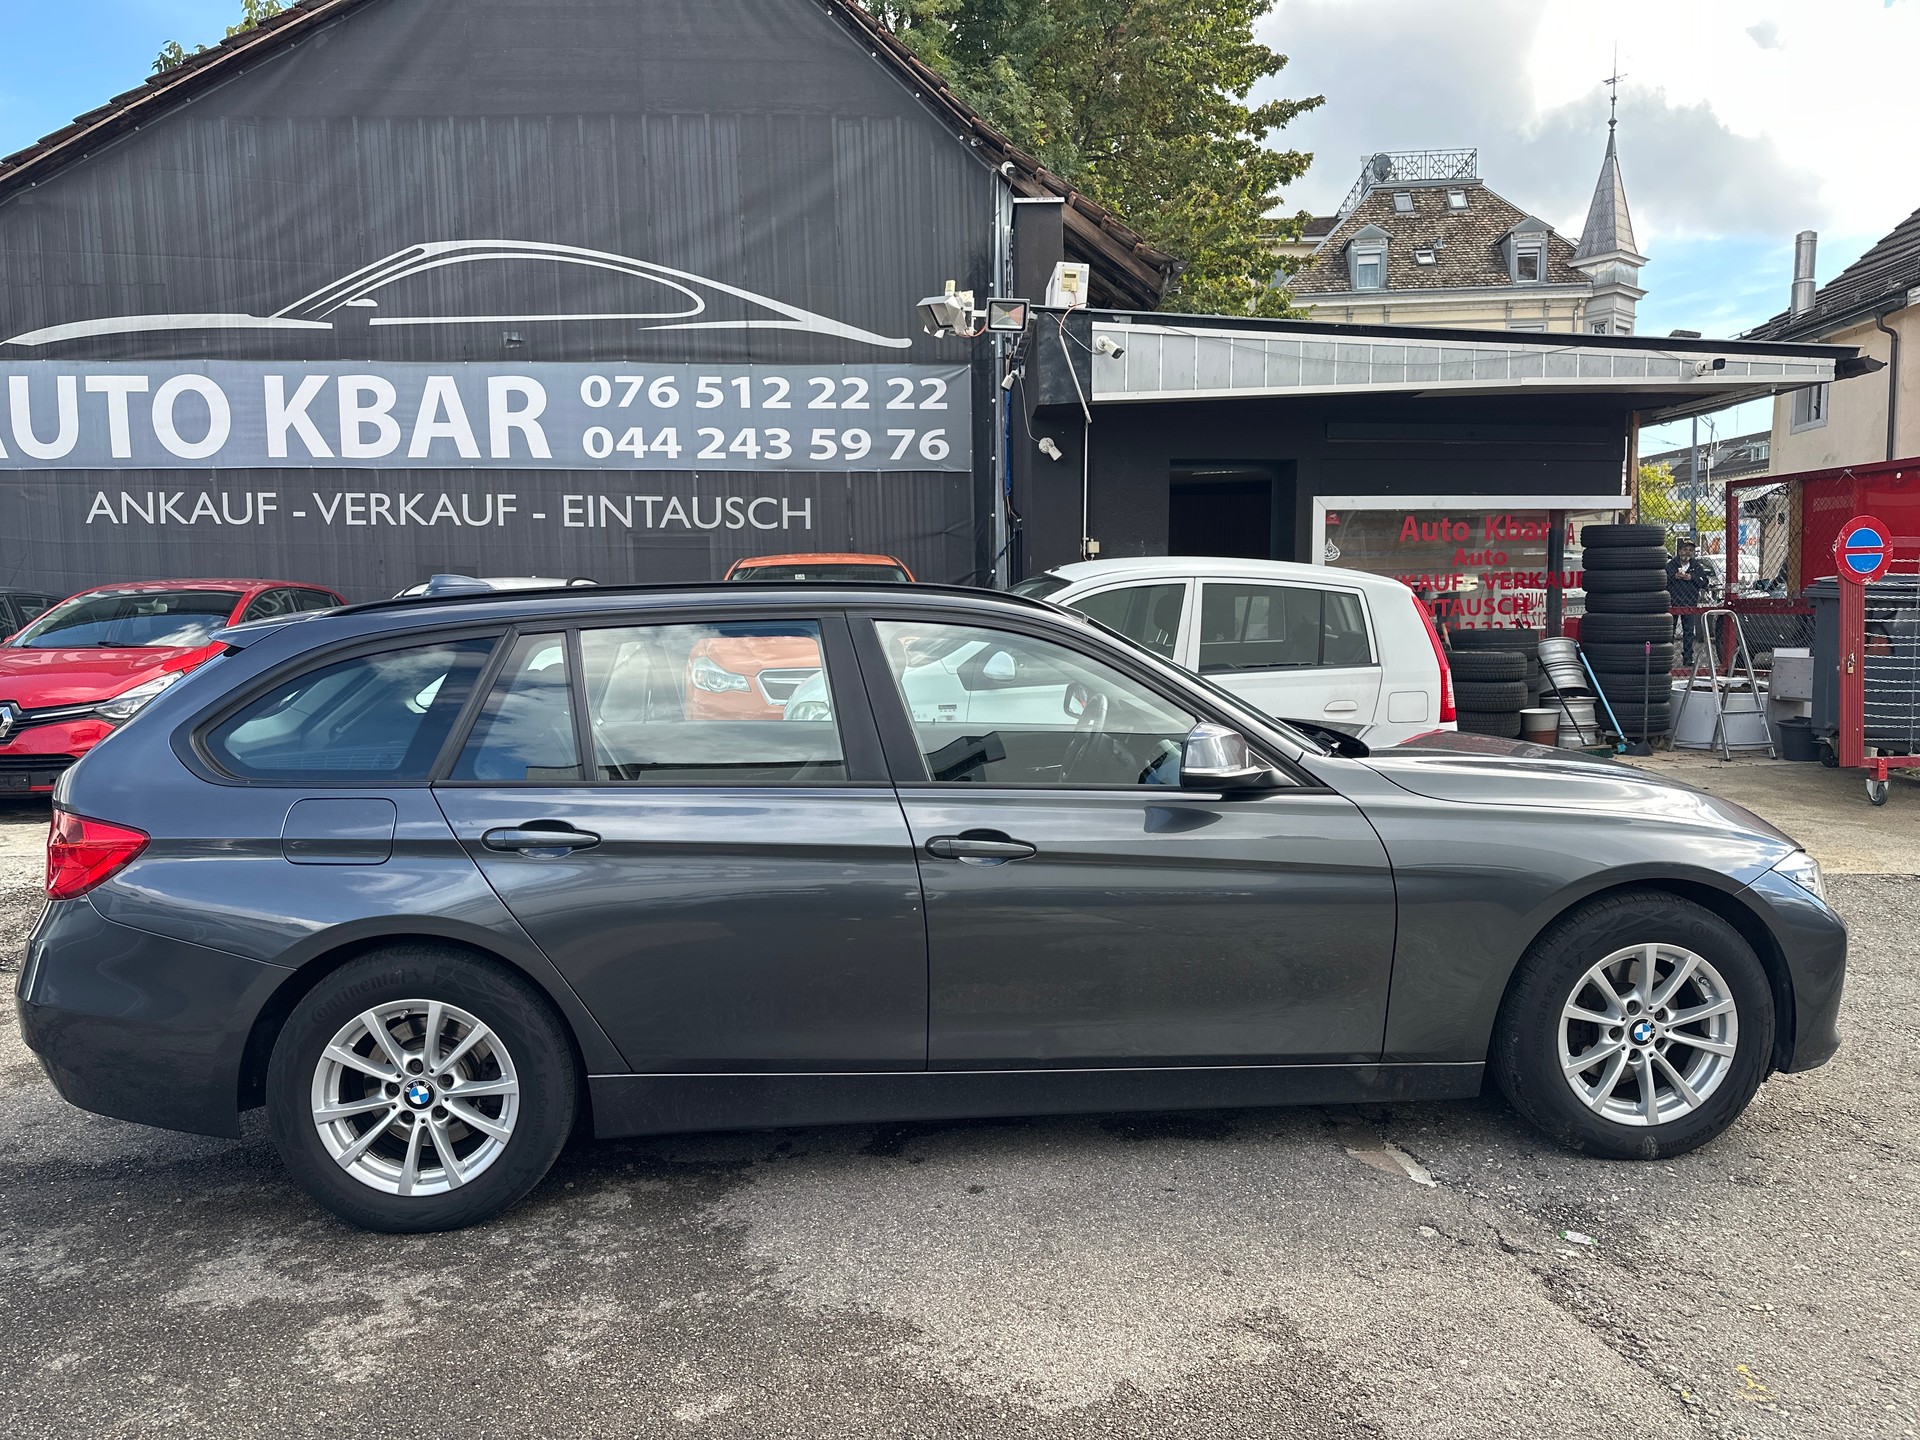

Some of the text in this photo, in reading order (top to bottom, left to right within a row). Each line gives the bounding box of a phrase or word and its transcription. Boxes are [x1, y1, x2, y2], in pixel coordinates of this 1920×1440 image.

[581, 375, 947, 410] 076 512 22 22
[0, 374, 552, 459] UTO KBAR
[583, 427, 949, 461] 044 243 59 76
[86, 491, 277, 525] ANKAUF
[313, 493, 516, 527] VERKAUF
[563, 495, 810, 530] EINTAUSCH
[1400, 514, 1551, 542] Auto Kbar
[1452, 548, 1507, 567] Auto
[311, 968, 406, 1024] Continental
